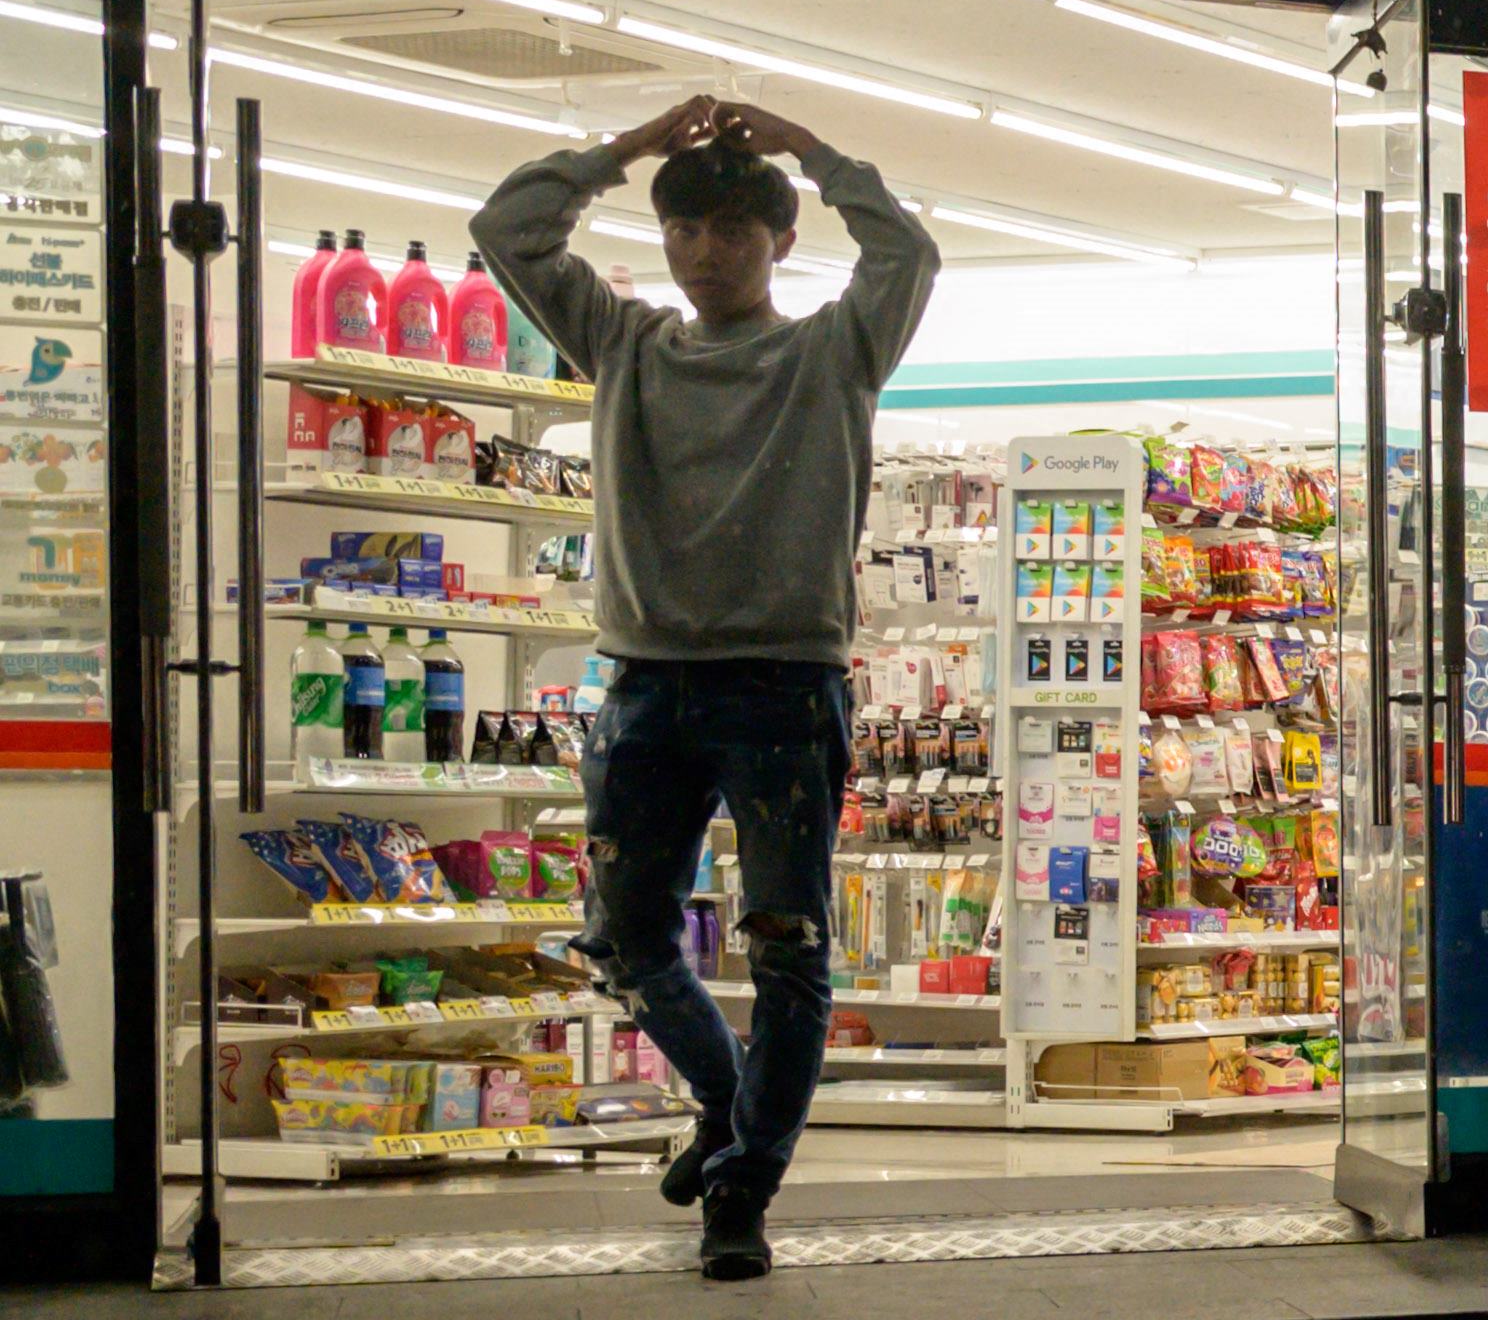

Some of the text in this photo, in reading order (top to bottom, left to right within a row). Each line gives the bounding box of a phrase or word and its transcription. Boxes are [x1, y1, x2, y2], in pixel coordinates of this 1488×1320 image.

[1044, 455, 1119, 475] Google Play
[1033, 691, 1097, 704] GIFT CARD
[533, 1063, 565, 1074] HARIBO
